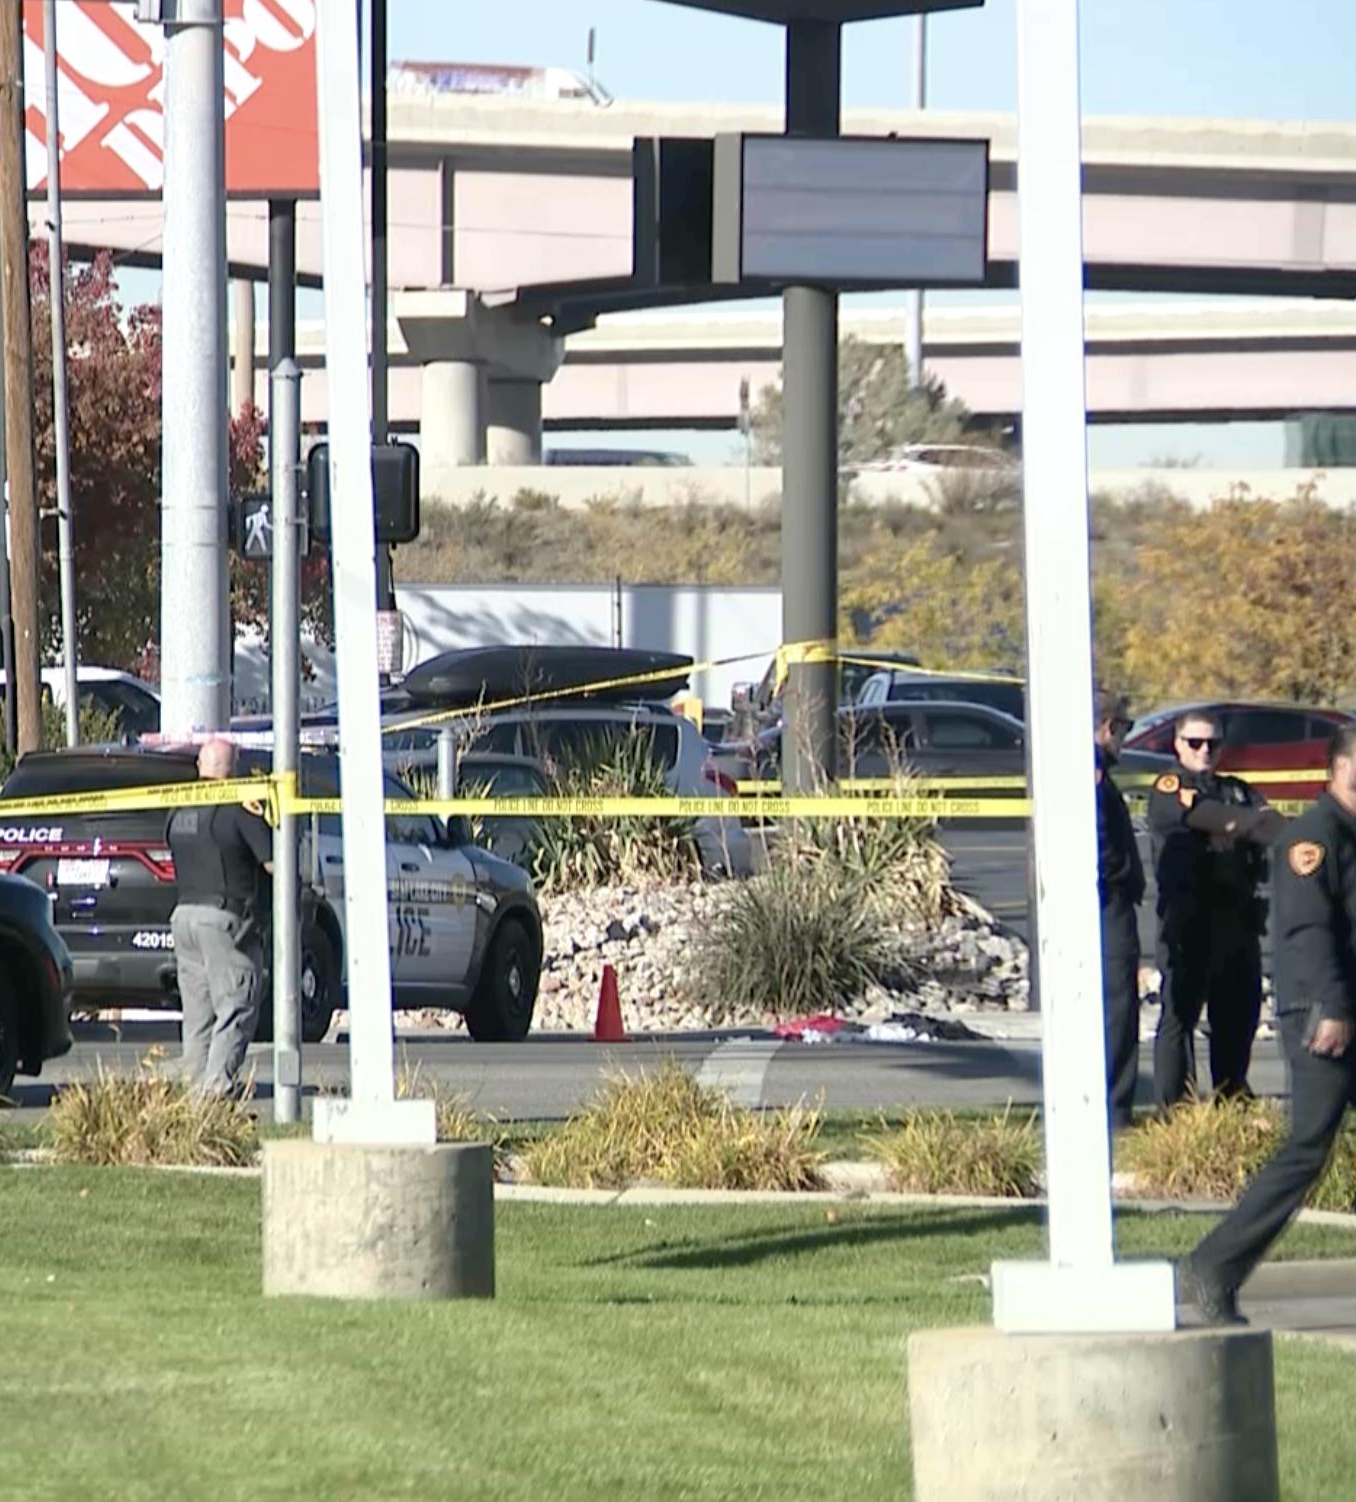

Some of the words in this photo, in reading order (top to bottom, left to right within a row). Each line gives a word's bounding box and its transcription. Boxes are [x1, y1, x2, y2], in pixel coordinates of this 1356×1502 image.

[494, 799, 519, 812] POLICE
[523, 799, 537, 812] LINE
[542, 799, 553, 812] DO
[557, 799, 571, 812] NOT
[576, 799, 604, 812] CROSS
[679, 800, 704, 813] POLICE
[708, 800, 724, 813] LINE
[728, 800, 739, 813] DO
[743, 800, 757, 813] NOT
[761, 800, 790, 813] CROSS
[867, 801, 892, 813] POLICE
[896, 801, 912, 813] LINE
[917, 801, 928, 813] DO
[931, 801, 946, 813] NOT
[950, 801, 980, 813] CROSS
